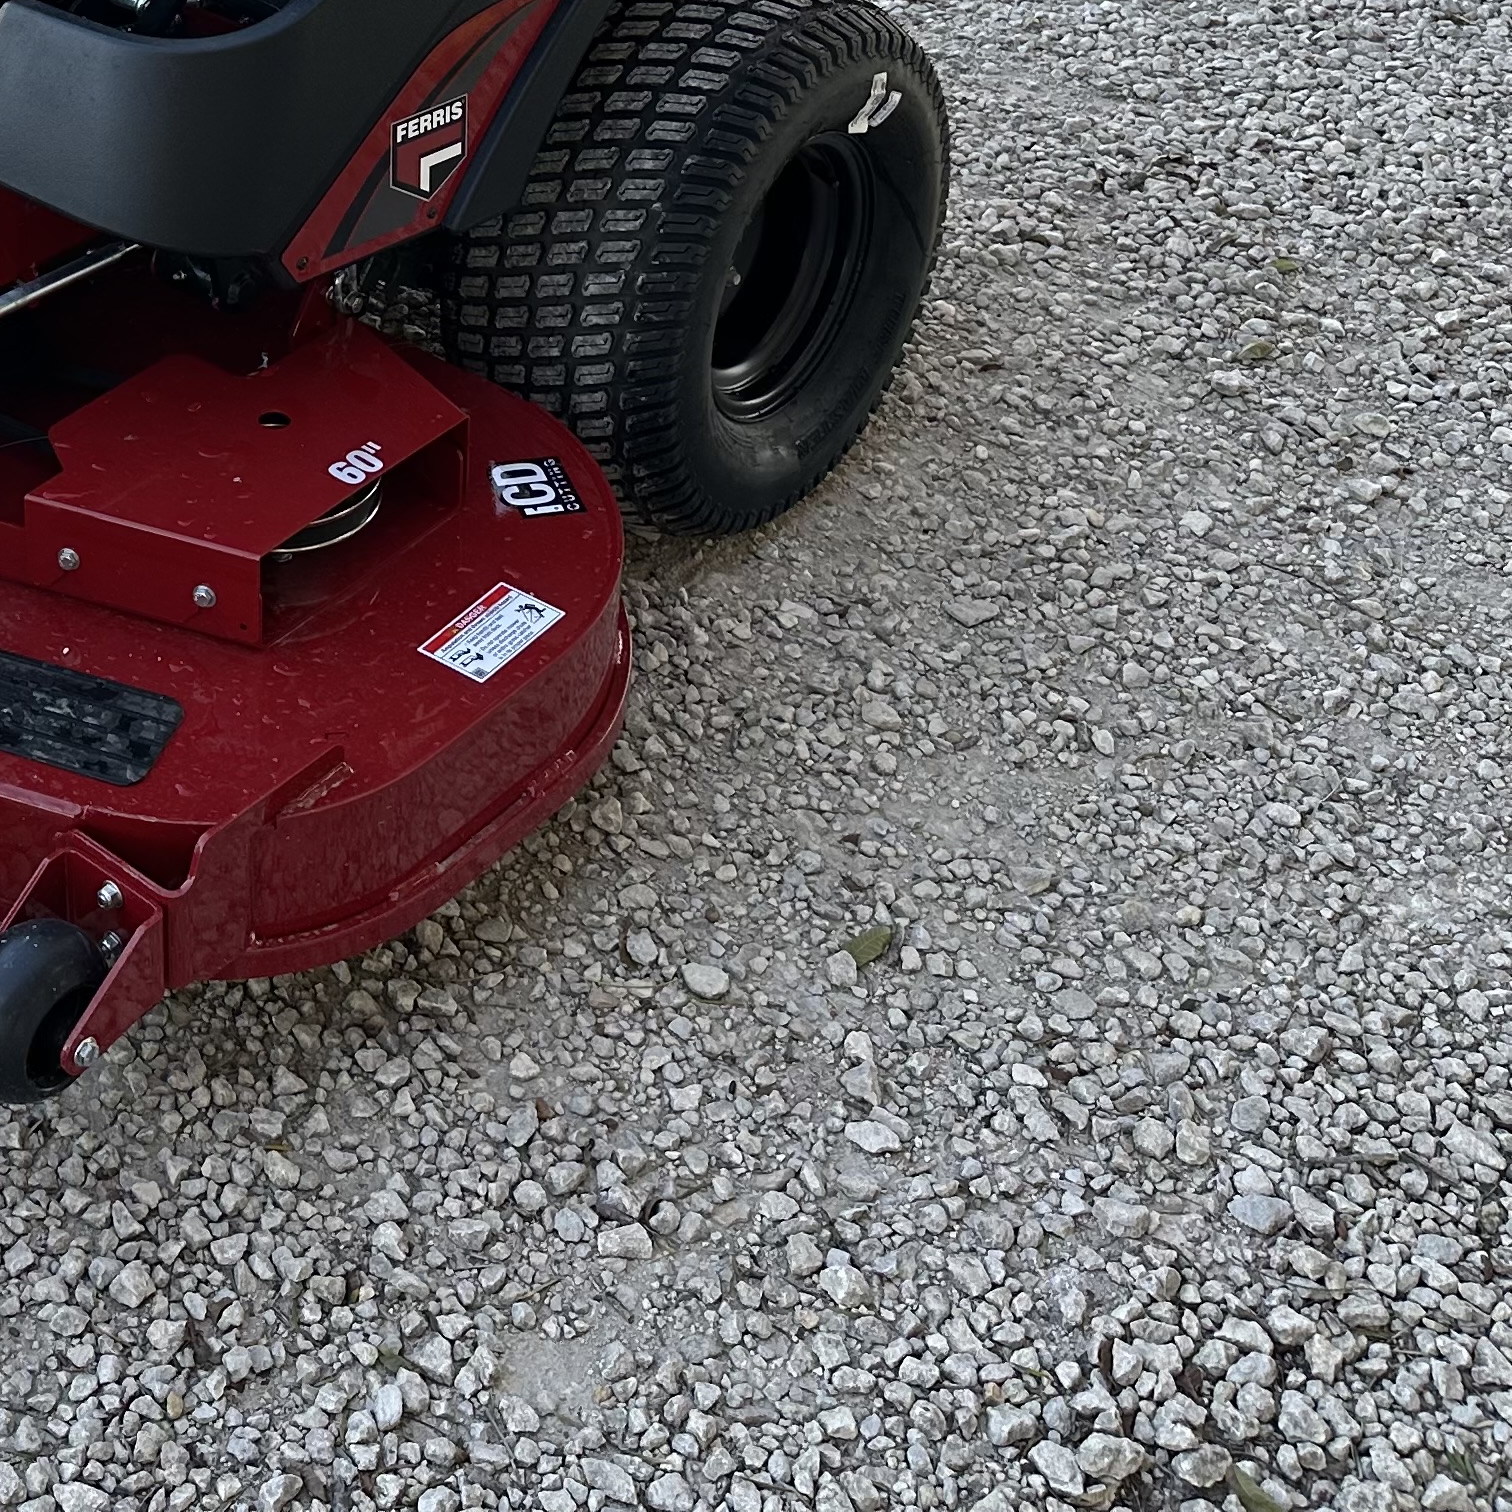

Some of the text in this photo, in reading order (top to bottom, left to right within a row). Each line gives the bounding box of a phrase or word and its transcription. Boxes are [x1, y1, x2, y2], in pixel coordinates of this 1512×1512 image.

[397, 101, 463, 143] FERRIS
[328, 441, 383, 484] 60"
[491, 462, 565, 516] ICD
[455, 605, 487, 628] DANGER
